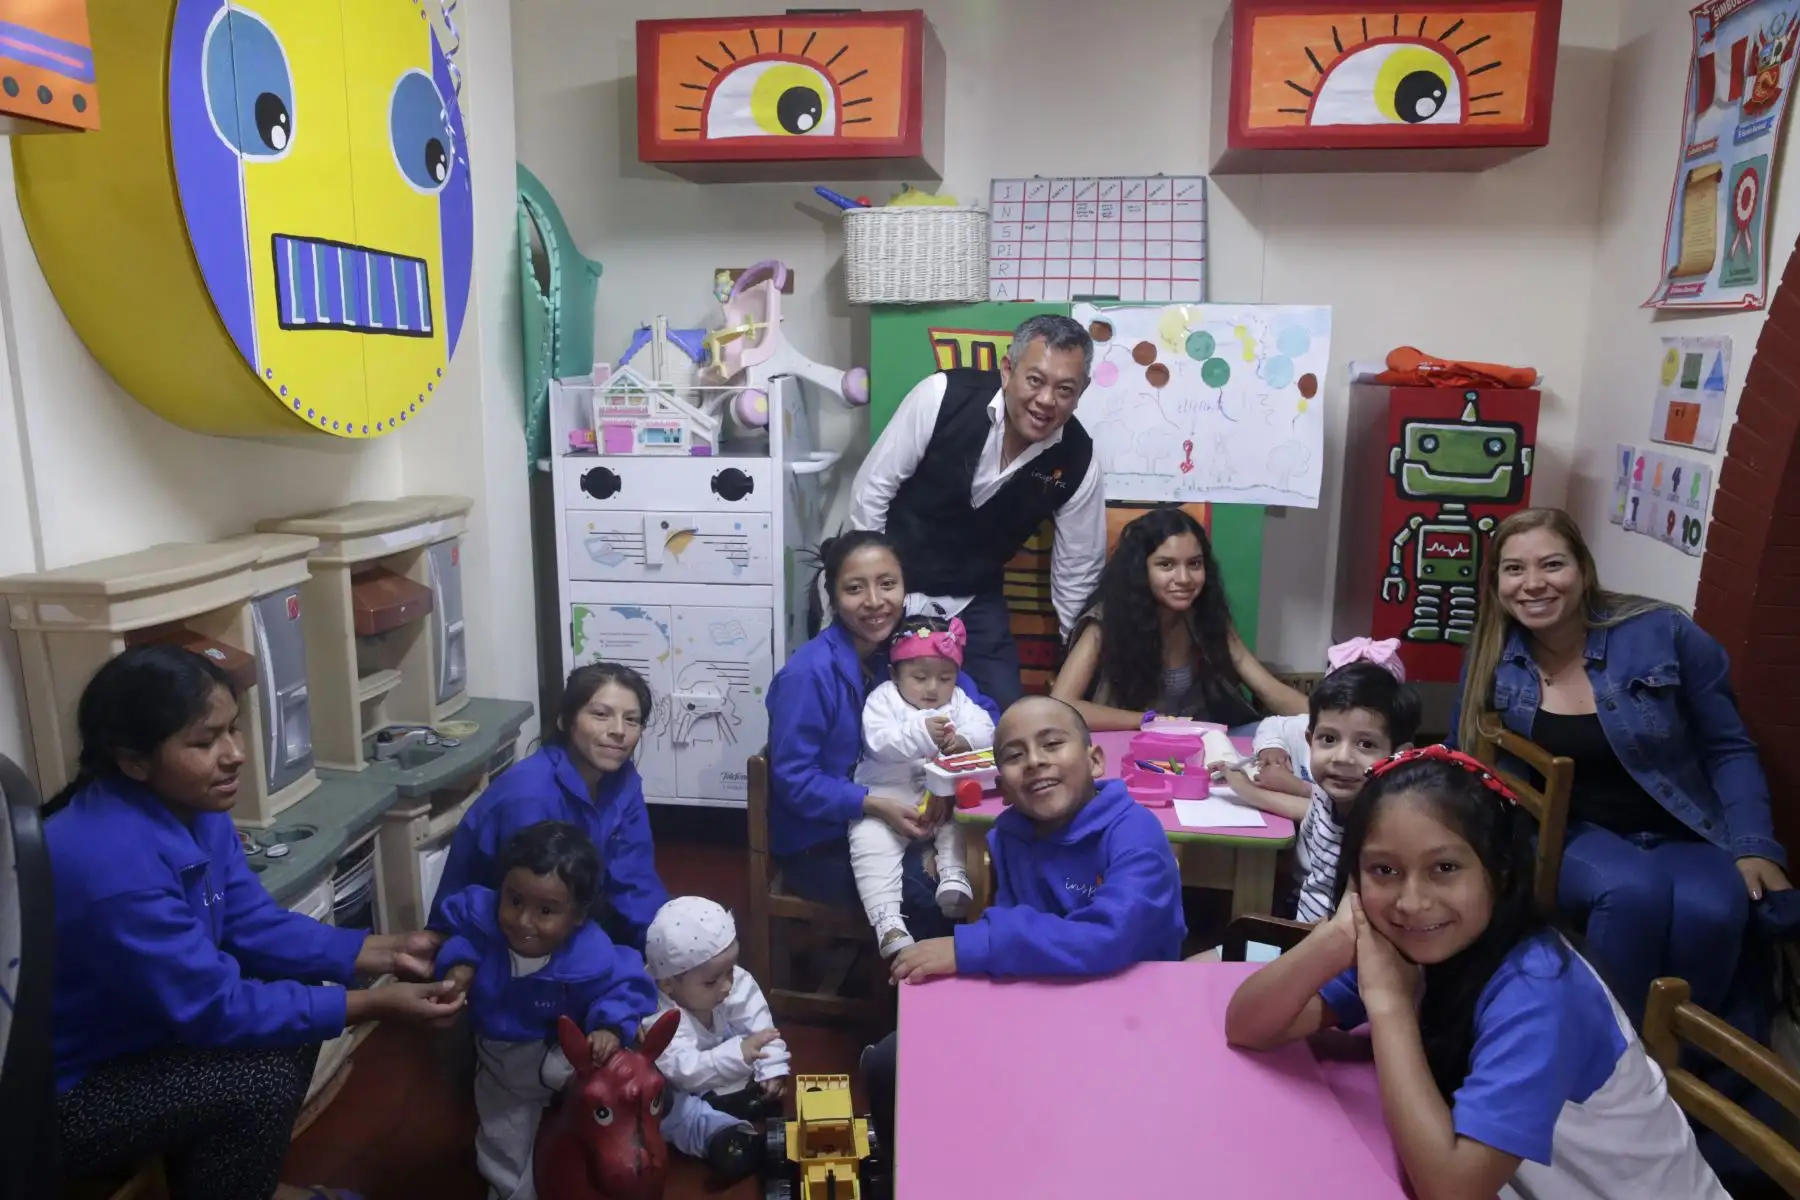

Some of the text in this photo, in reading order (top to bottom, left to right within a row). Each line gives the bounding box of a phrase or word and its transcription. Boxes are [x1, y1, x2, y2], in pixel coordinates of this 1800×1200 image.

[1001, 206, 1011, 218] N
[1002, 225, 1011, 238] S
[998, 262, 1009, 276] R
[996, 281, 1008, 297] A
[1682, 514, 1702, 547] 10
